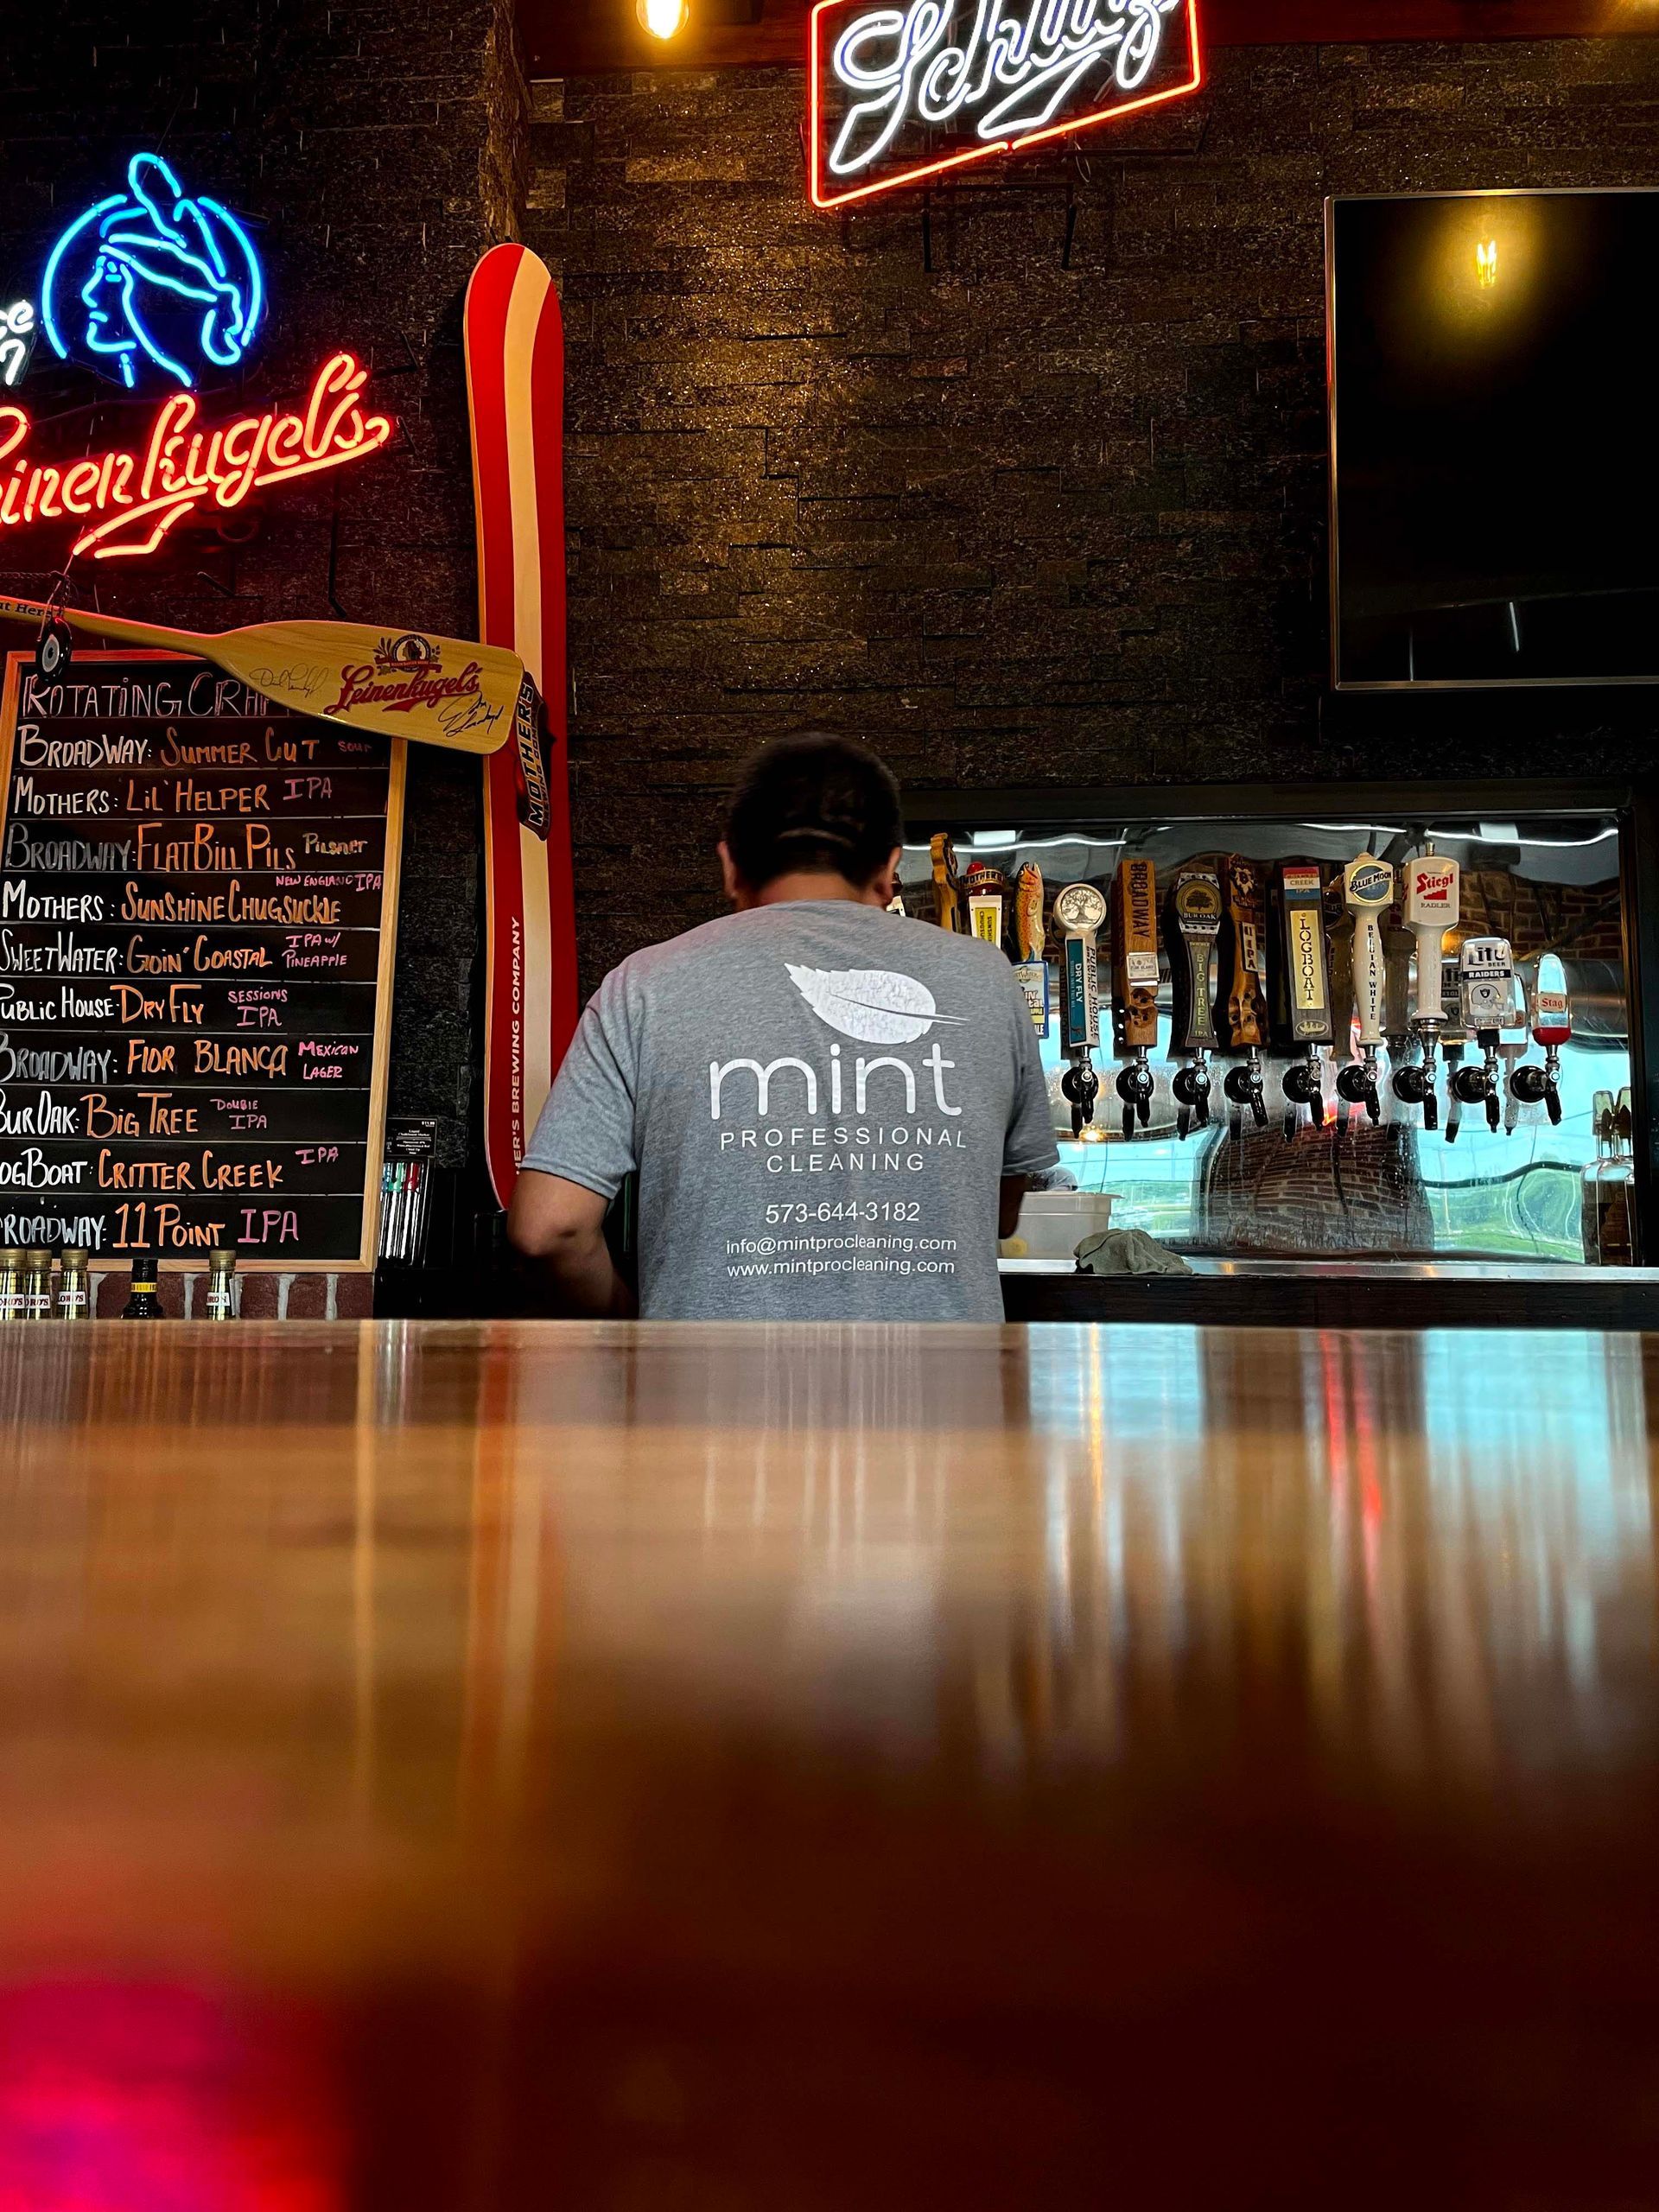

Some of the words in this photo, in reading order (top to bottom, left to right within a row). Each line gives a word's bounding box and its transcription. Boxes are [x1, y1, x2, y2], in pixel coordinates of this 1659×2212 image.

[0, 352, 389, 524] inenkugel's
[323, 661, 484, 715] Leinenkugel's
[17, 724, 152, 768] BROADWAY:
[160, 726, 257, 767] SUMMER
[265, 726, 320, 763] CUT
[14, 776, 118, 815] MOTHERS:
[175, 779, 271, 813] HELPER
[283, 777, 334, 801] IPA
[5, 823, 136, 871] BROADWAY:
[276, 874, 302, 887] NEW
[355, 874, 383, 893] IPA
[1130, 862, 1151, 938] BROADWAY
[1349, 875, 1372, 893] BLUE
[1373, 871, 1392, 883] MOON
[1416, 872, 1454, 894] Stiegl
[194, 934, 274, 972] COASTAL
[285, 933, 323, 949] IPA
[1299, 918, 1315, 1001] LOGBOAT
[511, 916, 522, 1015] COMPANY
[1089, 947, 1097, 993] PUBLIC
[1196, 953, 1205, 982] BIG
[1468, 969, 1505, 978] RAIDERS
[109, 984, 166, 1024] DRY
[168, 983, 205, 1025] FLY
[1075, 985, 1084, 1003] FLY
[1197, 987, 1206, 1026] TREE
[1368, 982, 1377, 1020] WHITE
[1541, 997, 1563, 1008] Stag
[236, 1006, 283, 1028] IPA
[302, 1063, 344, 1080] LAGER
[511, 1020, 521, 1115] BREWING
[709, 1043, 963, 1121] mint
[137, 1092, 199, 1136] TREE
[228, 1114, 268, 1130] IPA
[720, 1126, 967, 1151] PROFESSIONAL
[0, 1147, 94, 1188] OGBOAT:
[98, 1148, 196, 1191] CRITTER
[201, 1149, 284, 1191] CREEK
[295, 1146, 340, 1165] IPA
[766, 1153, 925, 1173] CLEANING
[0, 1212, 108, 1250] ROADWAY:
[112, 1201, 150, 1248] 11
[237, 1208, 300, 1243] IPA
[765, 1201, 921, 1224] 573-644-3182
[726, 1233, 957, 1255] info@mintprocleaning.com
[727, 1256, 956, 1277] www.mintprocleaning.com
